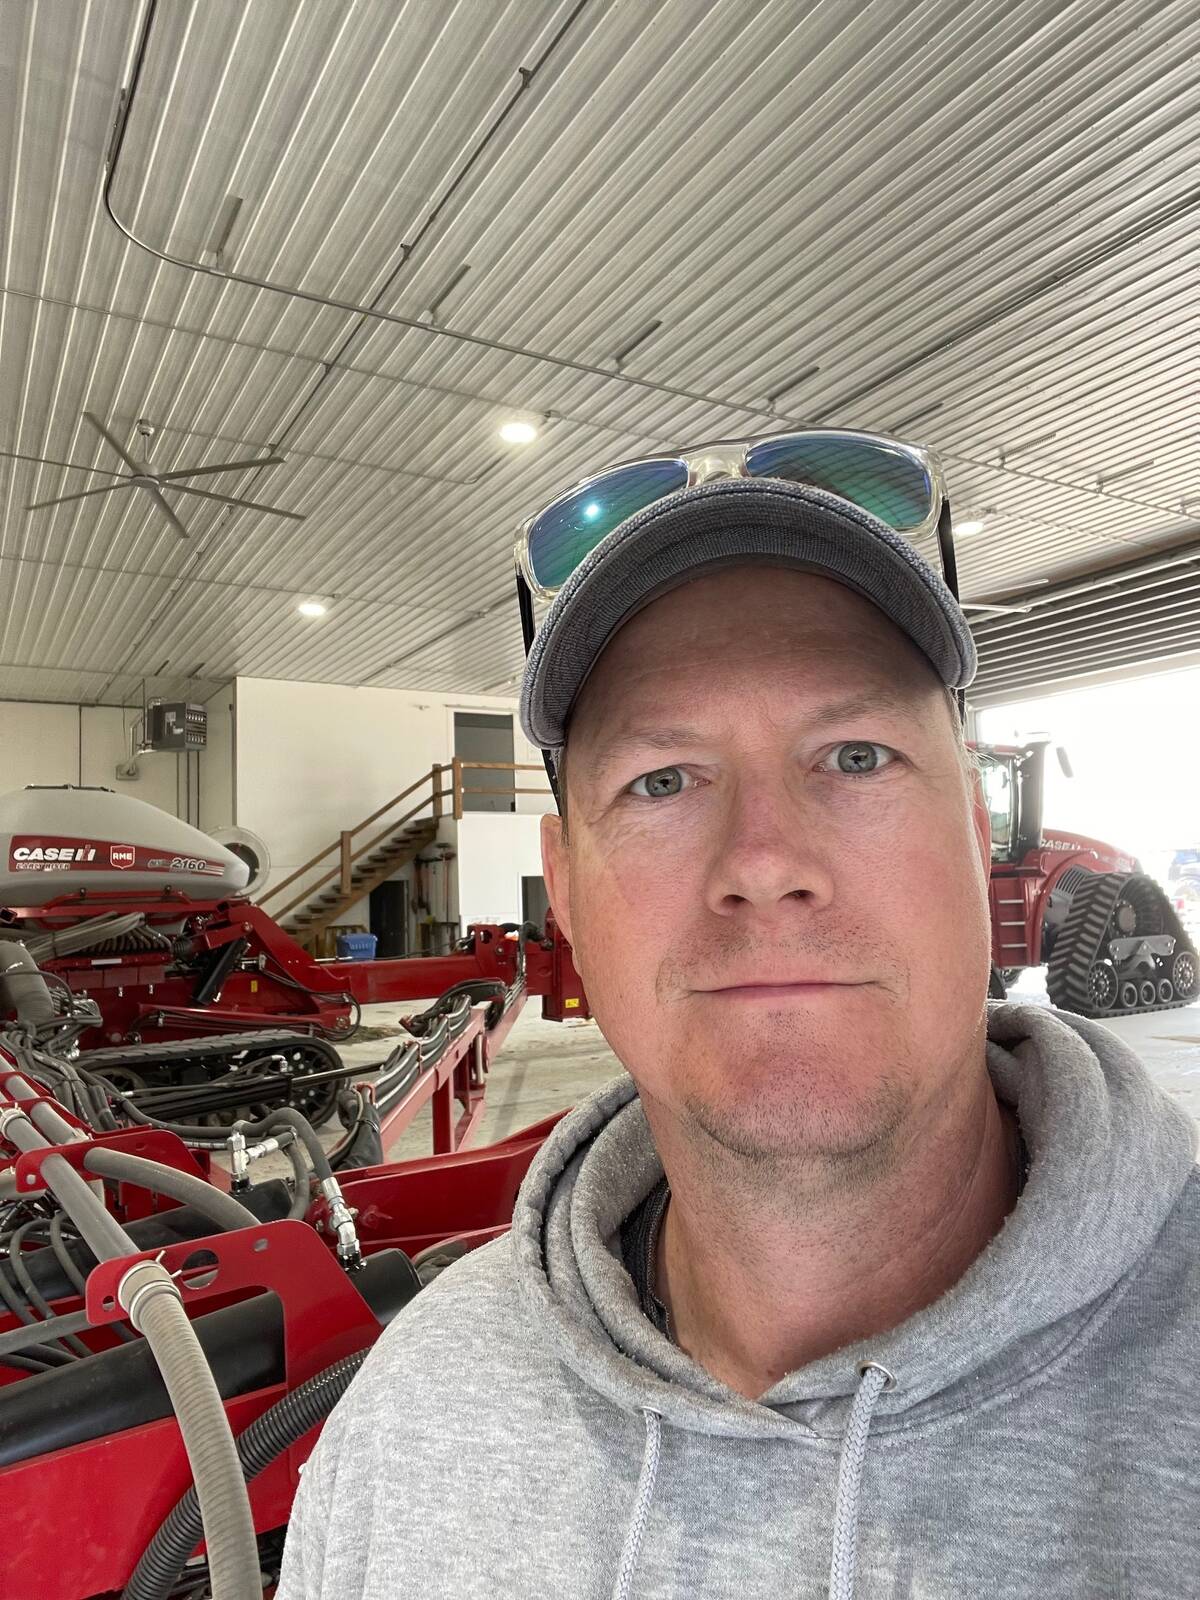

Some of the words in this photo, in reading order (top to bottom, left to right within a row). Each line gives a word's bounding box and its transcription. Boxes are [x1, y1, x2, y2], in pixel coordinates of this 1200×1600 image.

[13, 847, 75, 861] CASE
[112, 852, 133, 861] RME
[170, 857, 206, 871] 2160
